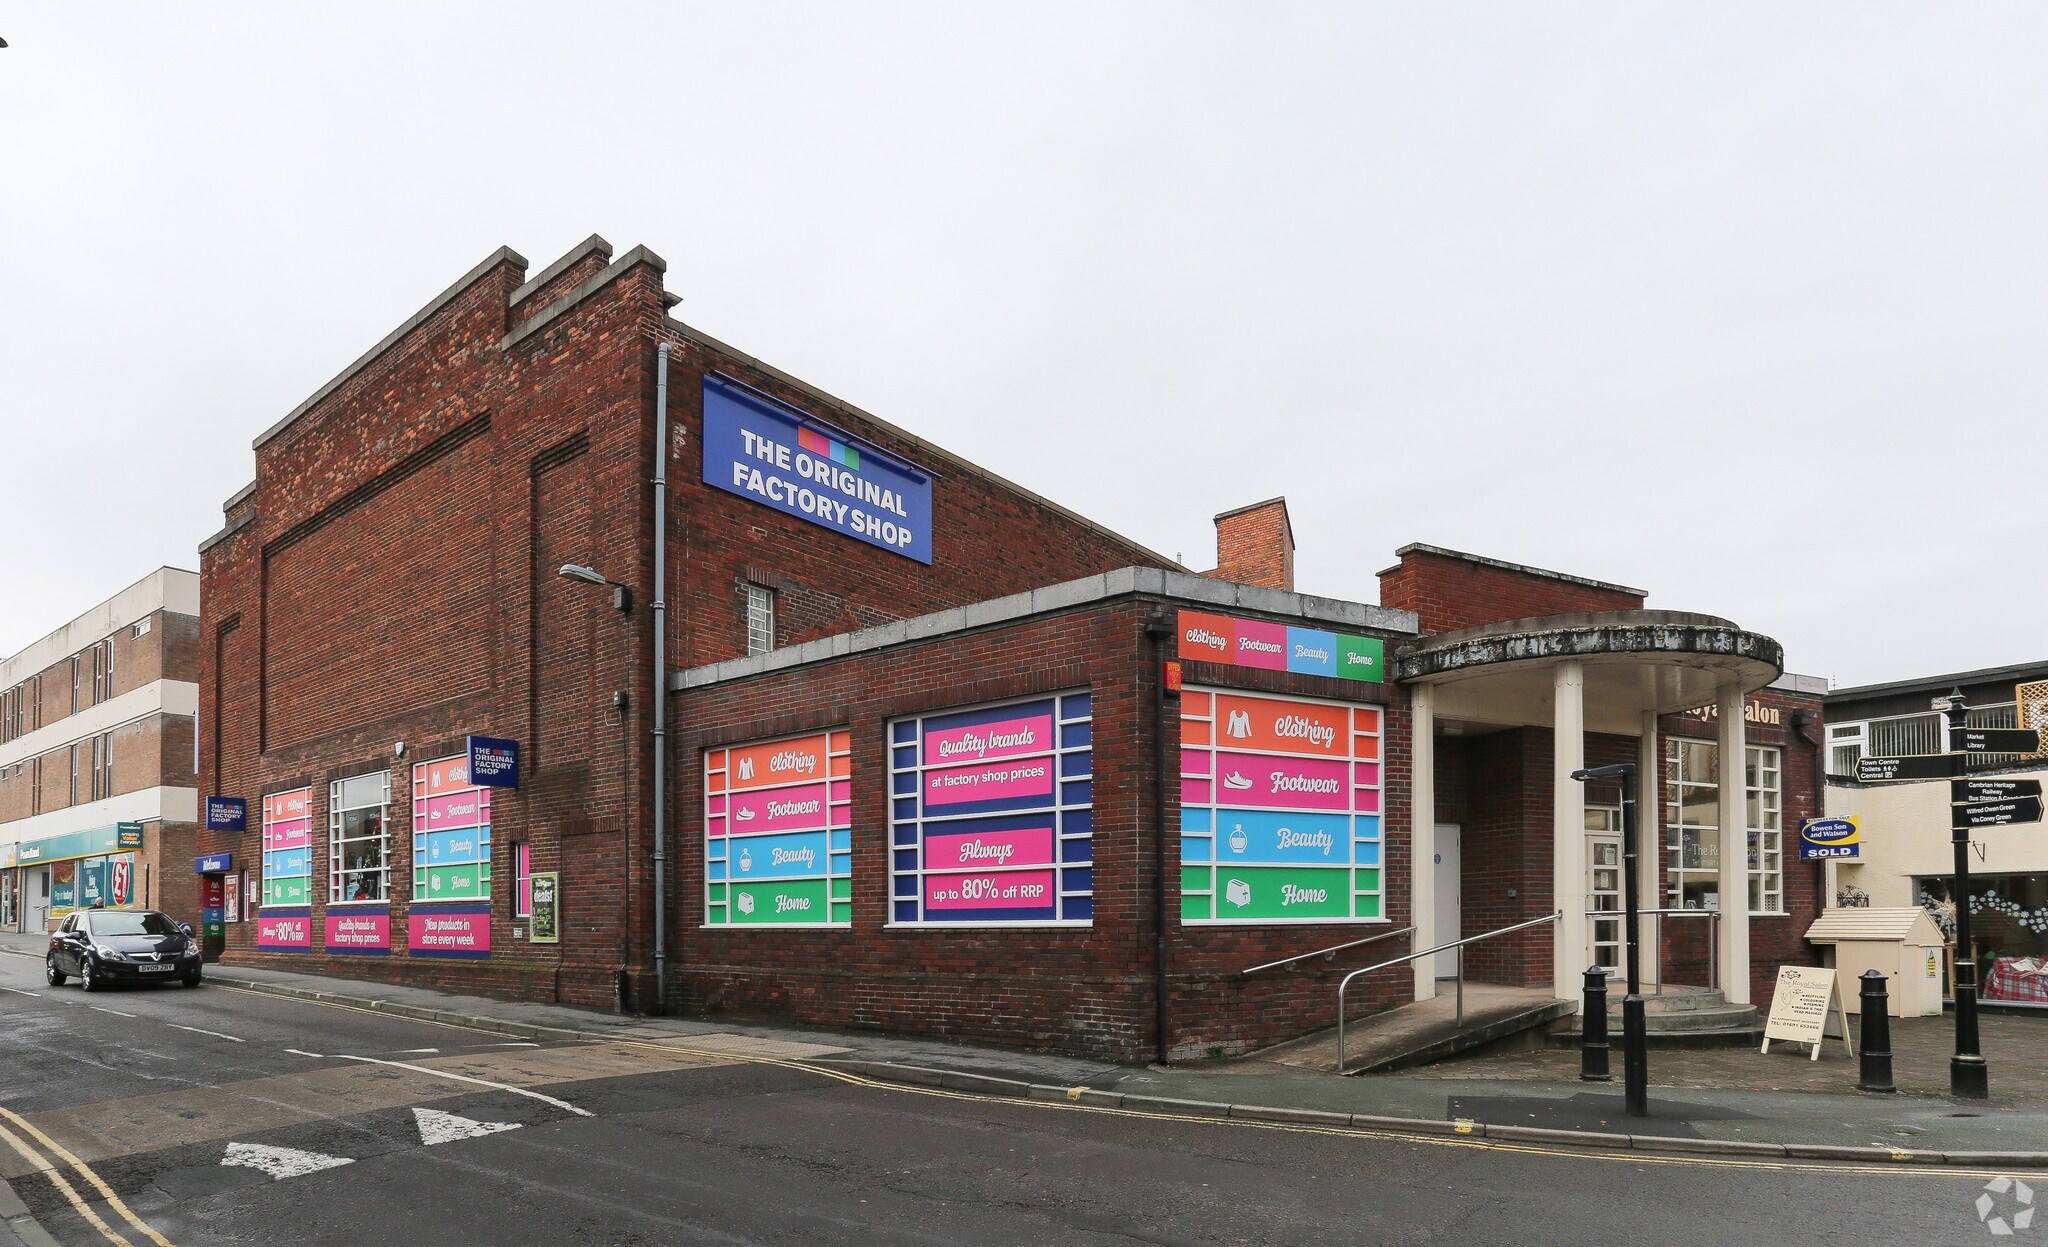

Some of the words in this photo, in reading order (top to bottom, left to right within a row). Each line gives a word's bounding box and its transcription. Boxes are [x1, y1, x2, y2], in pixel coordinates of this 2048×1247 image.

[740, 428, 792, 472] THE
[795, 453, 907, 518] ORIGINAL
[733, 460, 849, 526] FACTORY
[850, 509, 912, 548] SHOP
[1185, 627, 1228, 651] Clothing
[1238, 636, 1283, 655] Footwear
[1294, 644, 1329, 665] Beauty
[1346, 651, 1374, 667] Home
[1744, 700, 1780, 724] alon
[939, 732, 988, 758] Quality
[988, 724, 1036, 748] brands
[1274, 714, 1336, 749] Clothing
[474, 746, 491, 755] THE
[1966, 742, 1986, 750] Library
[474, 754, 515, 764] ORIGINAL
[475, 760, 512, 770] FACTORY
[769, 750, 817, 773] Clothing
[475, 767, 499, 775] SHOP
[931, 776, 942, 788] at
[943, 771, 980, 789] factory
[981, 767, 1008, 785] shop
[1010, 764, 1045, 783] prices
[1270, 771, 1340, 795] Footwear
[287, 798, 305, 814] Clothing
[446, 801, 476, 819] Footwear
[766, 797, 821, 821] Footwear
[1966, 806, 1984, 814] Wilfred
[449, 838, 473, 856] Beauty
[958, 838, 1014, 864] Always
[1276, 826, 1334, 857] Beauty
[1692, 843, 1708, 855] The
[770, 844, 816, 869] Beauty
[1808, 847, 1851, 857] SOLD
[115, 863, 127, 898] £1
[451, 874, 471, 889] Home
[933, 889, 946, 903] up
[947, 888, 959, 900] to
[961, 878, 999, 901] 80%
[1002, 884, 1018, 899] off
[1020, 884, 1044, 898] RRP
[533, 889, 552, 903] deals!
[775, 894, 811, 915] Home
[1280, 883, 1328, 907] Home
[278, 921, 295, 942] 80%
[338, 917, 355, 933] Quality
[354, 916, 370, 931] brands
[370, 919, 376, 930] at
[424, 918, 437, 931] New
[437, 916, 463, 934] products
[463, 918, 470, 930] in
[334, 932, 350, 945] factory
[350, 931, 364, 945] shop
[364, 930, 380, 944] prices
[421, 933, 438, 945] store
[438, 934, 457, 948] every
[457, 932, 475, 945] week
